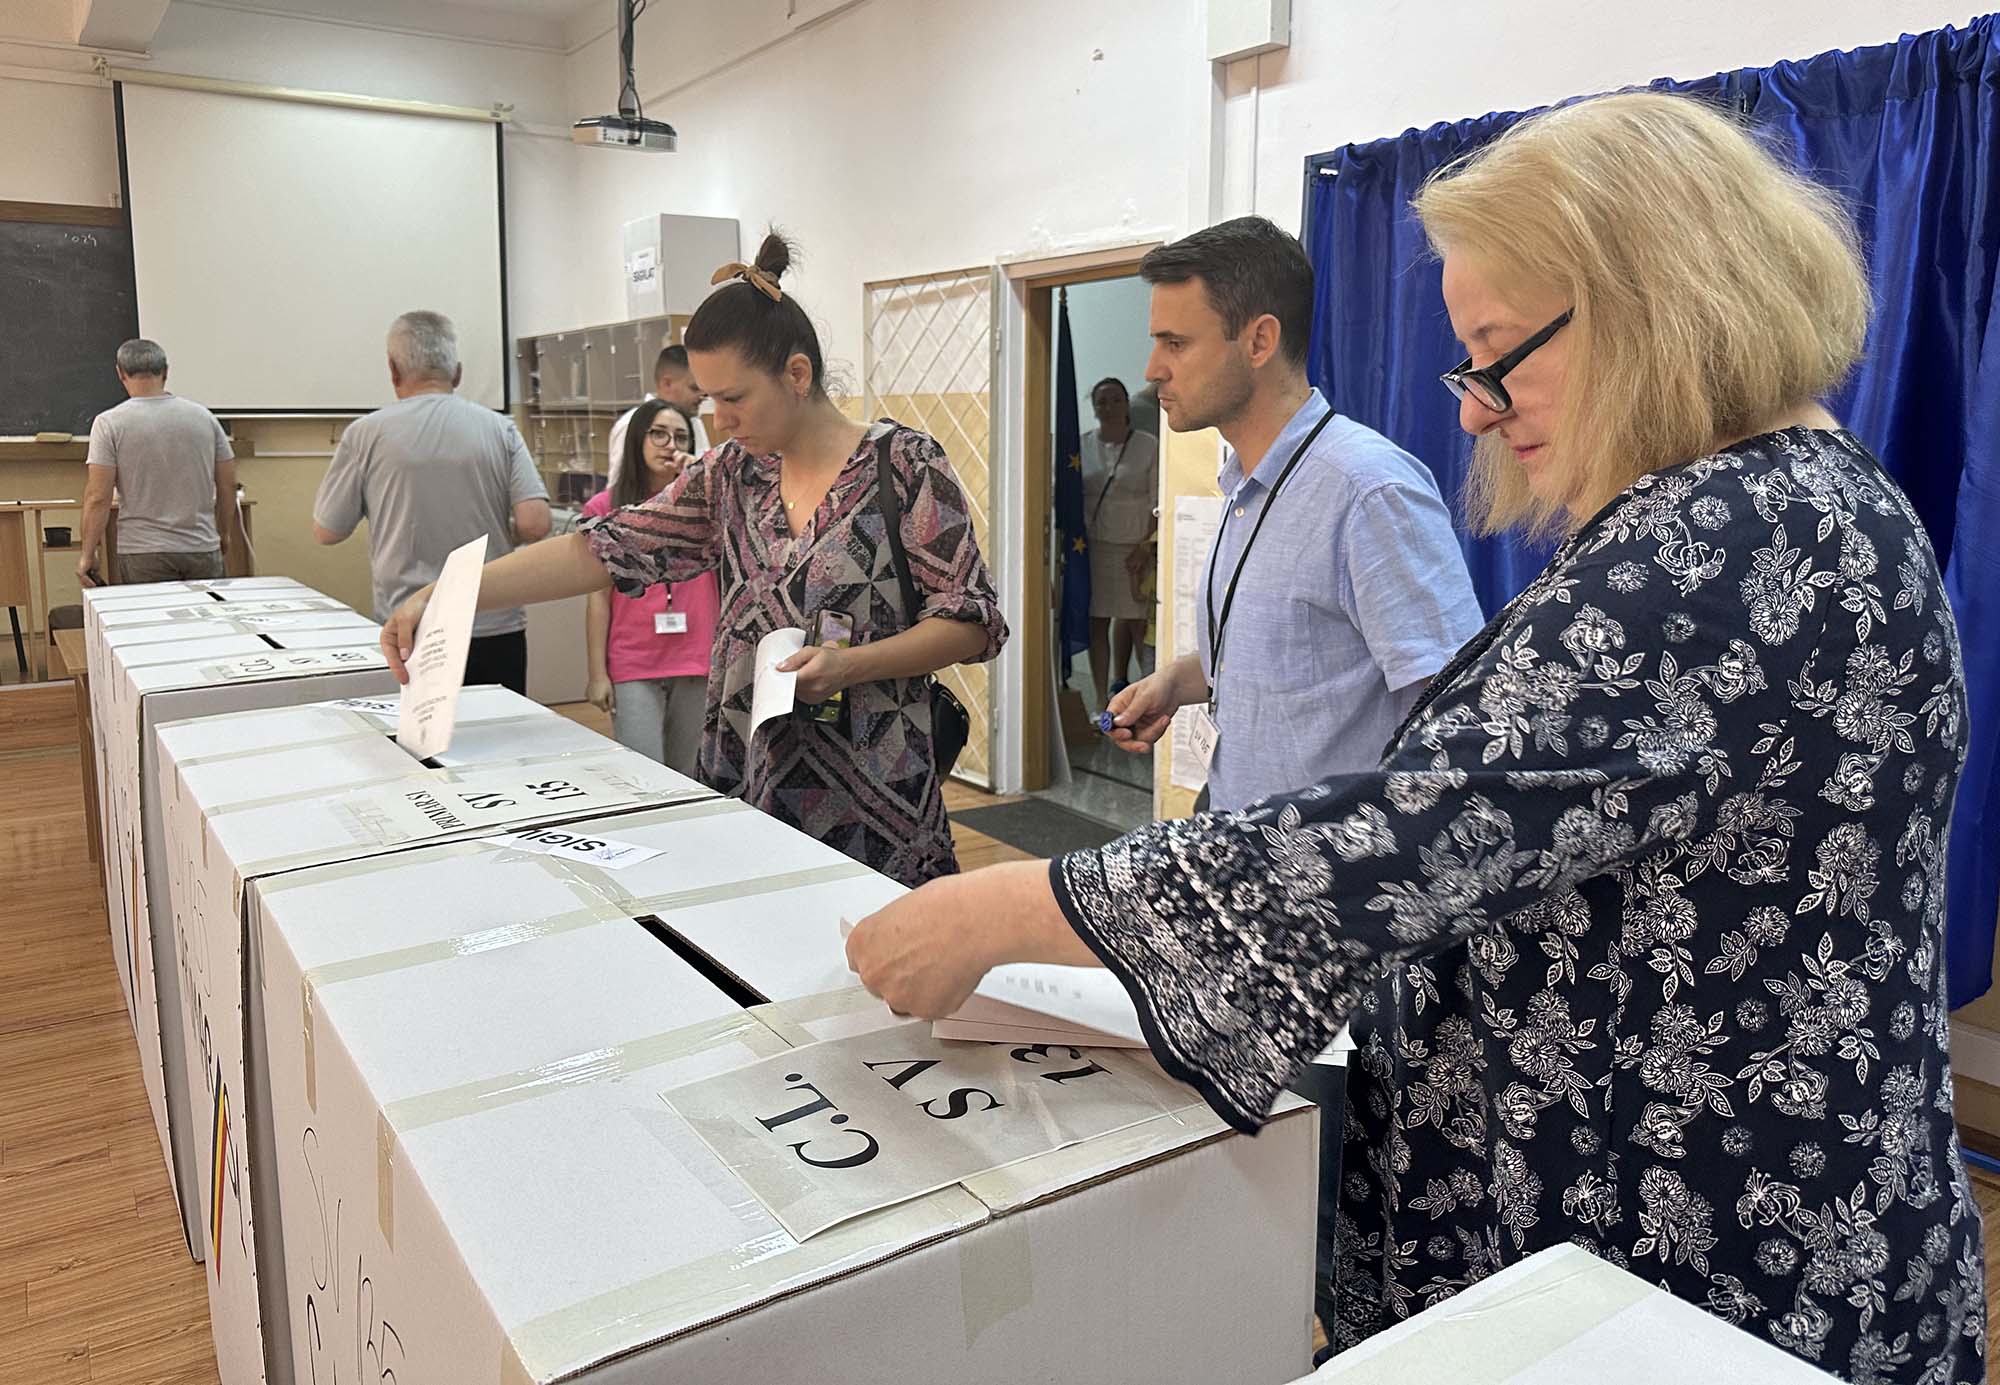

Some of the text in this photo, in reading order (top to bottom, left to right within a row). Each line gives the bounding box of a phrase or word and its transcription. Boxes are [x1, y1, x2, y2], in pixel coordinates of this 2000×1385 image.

[457, 793, 516, 809] SV
[525, 780, 588, 800] 135
[1008, 1044, 1112, 1085] 13
[863, 1060, 1005, 1120] SV
